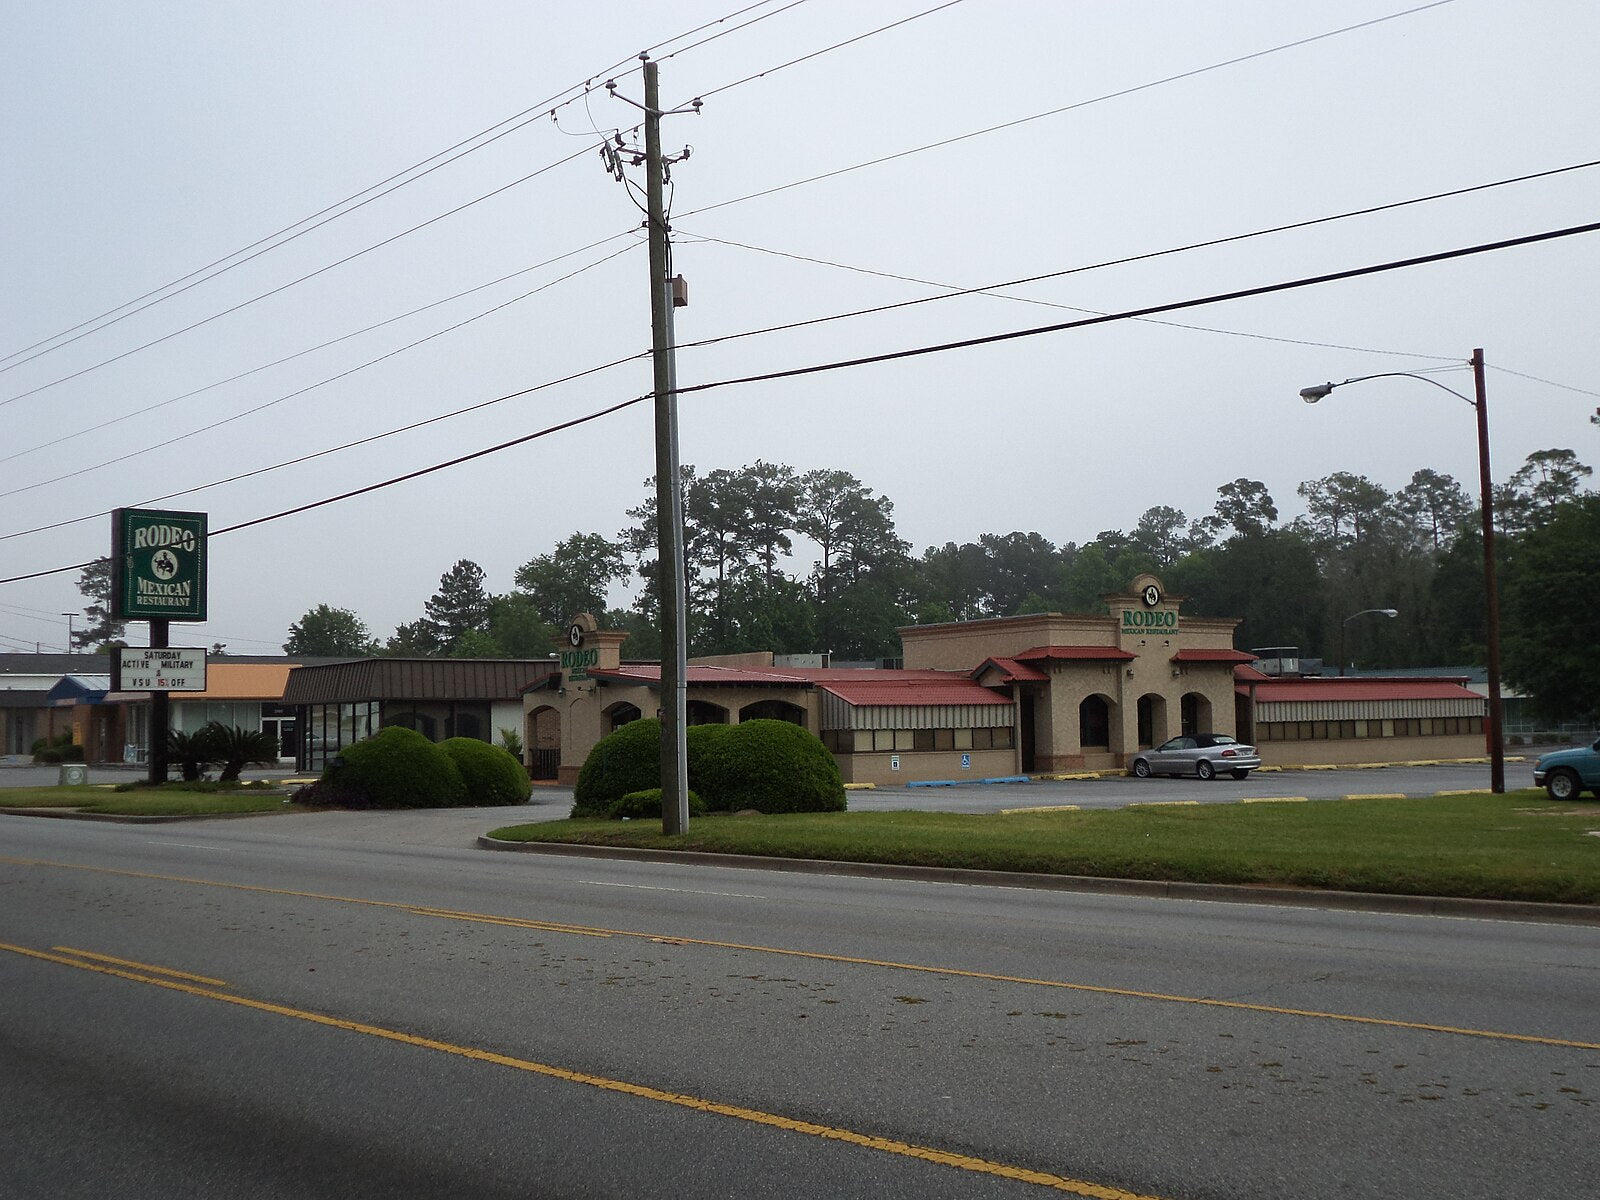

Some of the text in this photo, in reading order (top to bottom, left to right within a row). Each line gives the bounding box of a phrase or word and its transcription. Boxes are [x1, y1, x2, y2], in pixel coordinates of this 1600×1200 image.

[134, 524, 195, 552] RODEO
[137, 576, 191, 597] MEXICAN
[136, 595, 190, 607] RESTAURANT
[1122, 610, 1177, 627] RODEO
[144, 651, 181, 660] SATURDAY
[561, 648, 598, 668] RODEO
[122, 660, 194, 669] ACTIVE MILITARY
[171, 678, 186, 687] OFF
